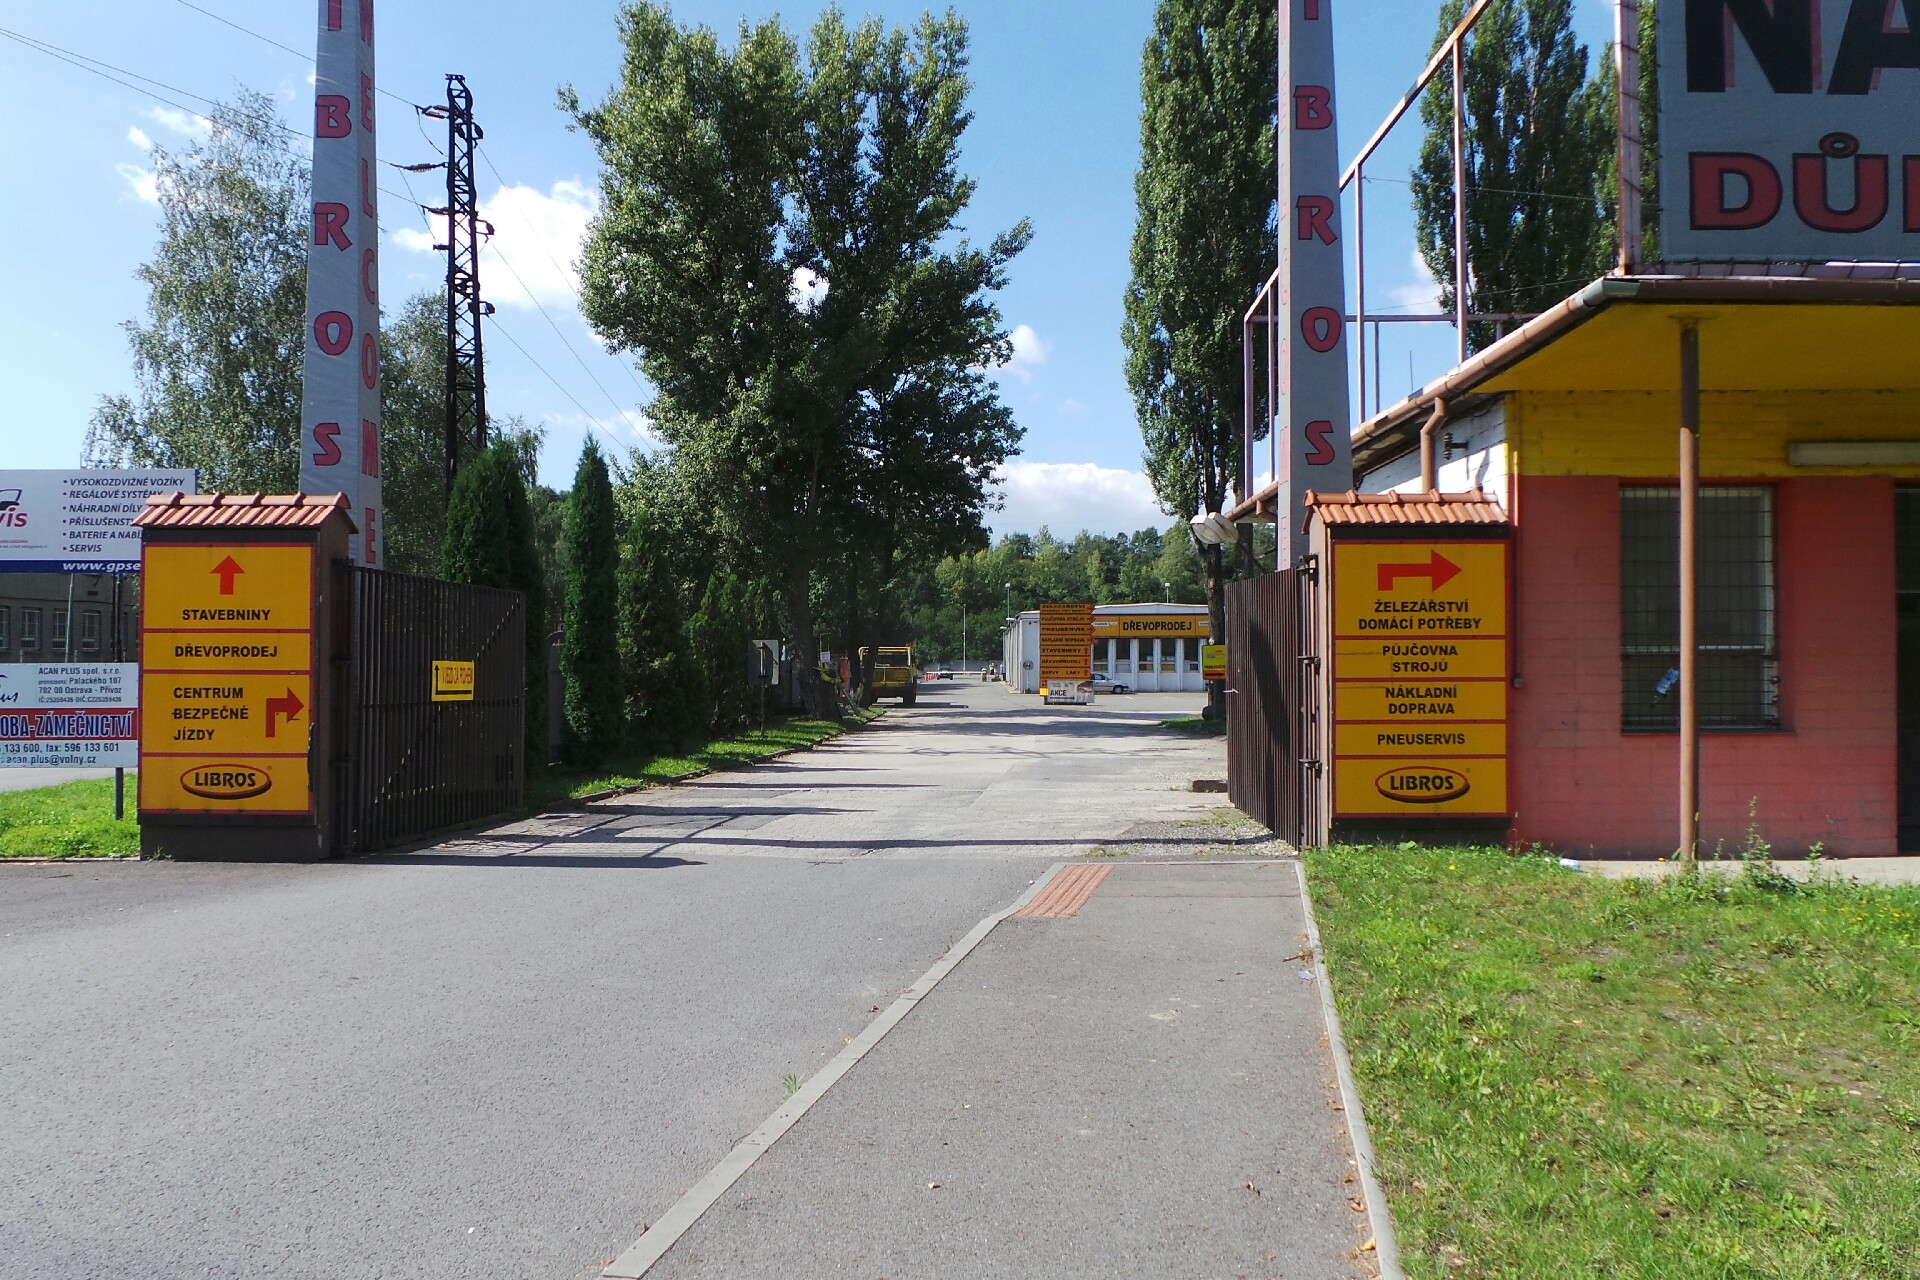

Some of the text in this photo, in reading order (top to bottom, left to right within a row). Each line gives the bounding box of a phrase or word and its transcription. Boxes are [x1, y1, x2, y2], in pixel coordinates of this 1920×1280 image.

[1688, 131, 1920, 234] DŮ
[70, 477, 185, 486] VYSOKOZDVIŽNÉ VOZÍKY
[69, 489, 120, 498] REGÁLOVÉ
[68, 503, 143, 513] NÁHRADNÍ DÍLY
[69, 529, 142, 540] BATERIE A NABÍ
[69, 544, 102, 553] SERVIS
[62, 562, 141, 572] www.gpse
[1374, 598, 1469, 612] ŽELEZÁŘSTVÍ
[182, 609, 271, 620] STAVEBNINY
[1122, 620, 1192, 631] DŘEVOPRODEJ
[1359, 616, 1482, 629] DOMÁCÍ POTŘEBY
[175, 643, 278, 657] DŘEVOPRODEJ
[1382, 643, 1458, 656] PŮJČOVNA
[38, 667, 59, 675] ACAN
[60, 667, 81, 675] PLUS
[1392, 659, 1448, 672] STROJŮ
[173, 687, 244, 699] CENTRUM
[1050, 689, 1067, 697] AKCE
[1385, 685, 1457, 698] NÁKLADNÍ
[173, 705, 249, 720] BEZPEČNÉ
[1388, 703, 1455, 714] DOPRAVA
[173, 726, 215, 740] JÍZDY
[1377, 733, 1466, 745] PNEUSERVIS
[4, 744, 20, 753] 133
[46, 743, 61, 752] fax:
[64, 743, 81, 752] 596
[84, 742, 100, 751] 133
[103, 742, 119, 751] 601
[6, 754, 97, 765] acan.plus@volny.cz
[194, 772, 256, 788] LIBROS
[1390, 775, 1454, 791] LIBROS
